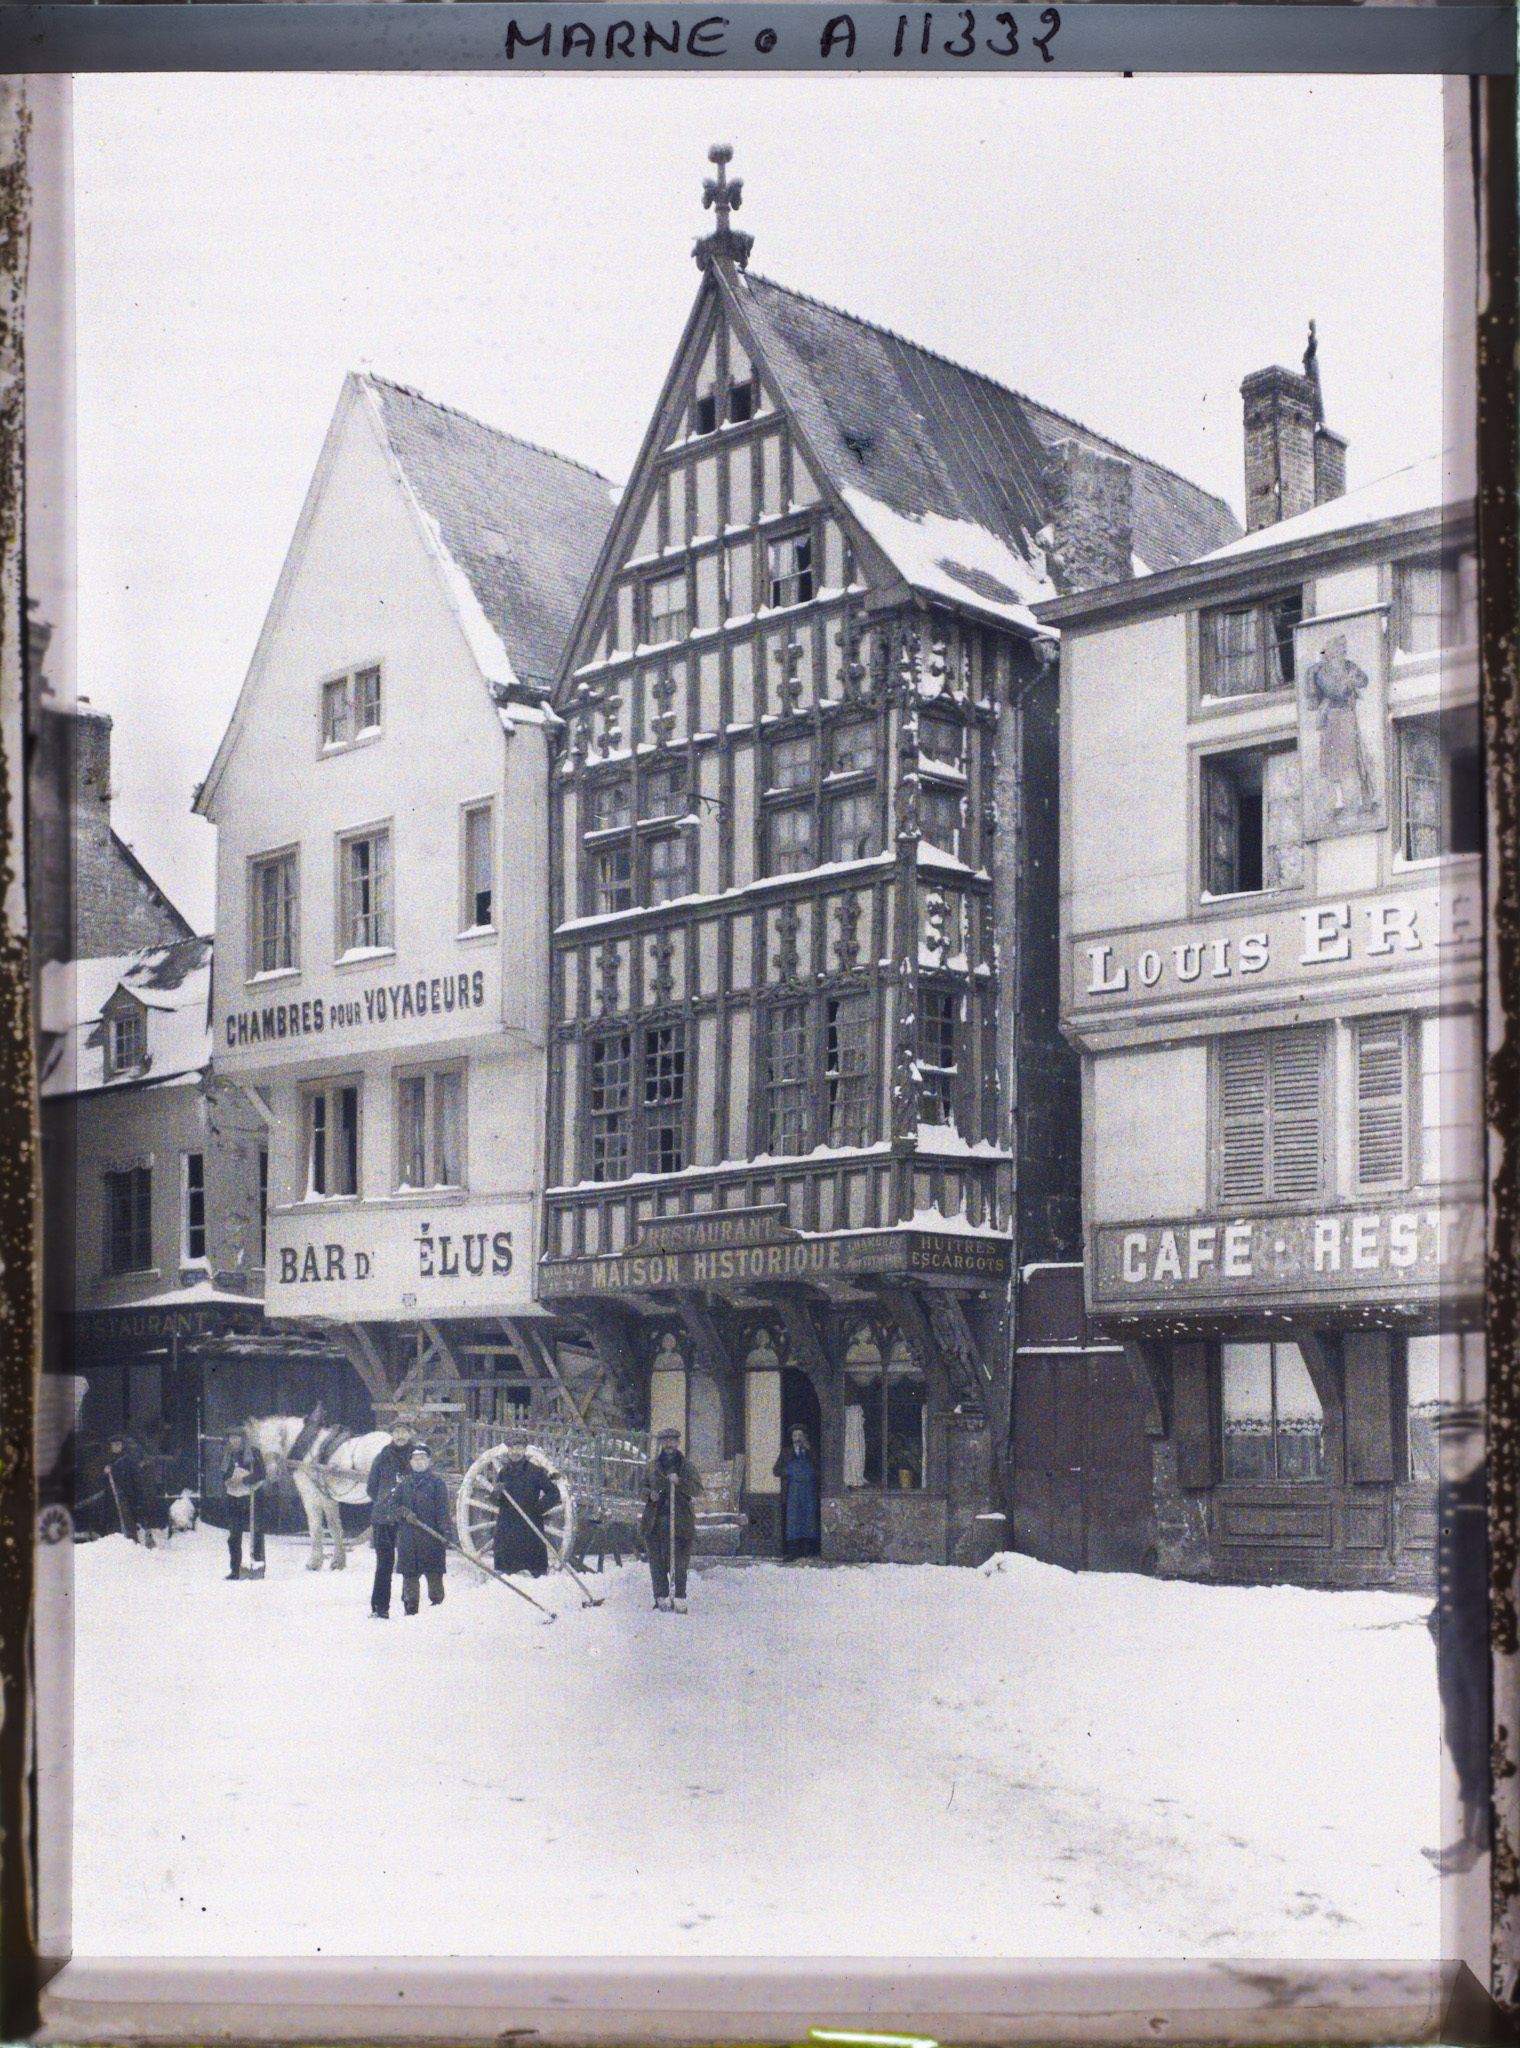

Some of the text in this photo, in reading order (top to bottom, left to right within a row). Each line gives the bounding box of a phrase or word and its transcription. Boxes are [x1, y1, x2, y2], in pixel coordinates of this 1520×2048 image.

[1087, 931, 1270, 995] LOUIS
[226, 970, 485, 1047] CHAMBRES POUR VOYAGEURS
[646, 1215, 775, 1248] RESTAURANT
[1122, 1219, 1253, 1283] CAFÉ
[279, 1242, 347, 1285] BAR
[592, 1254, 679, 1289] MAISON
[693, 1241, 840, 1281] HISTORIQUE
[911, 1250, 1005, 1273] ESCARGOTS
